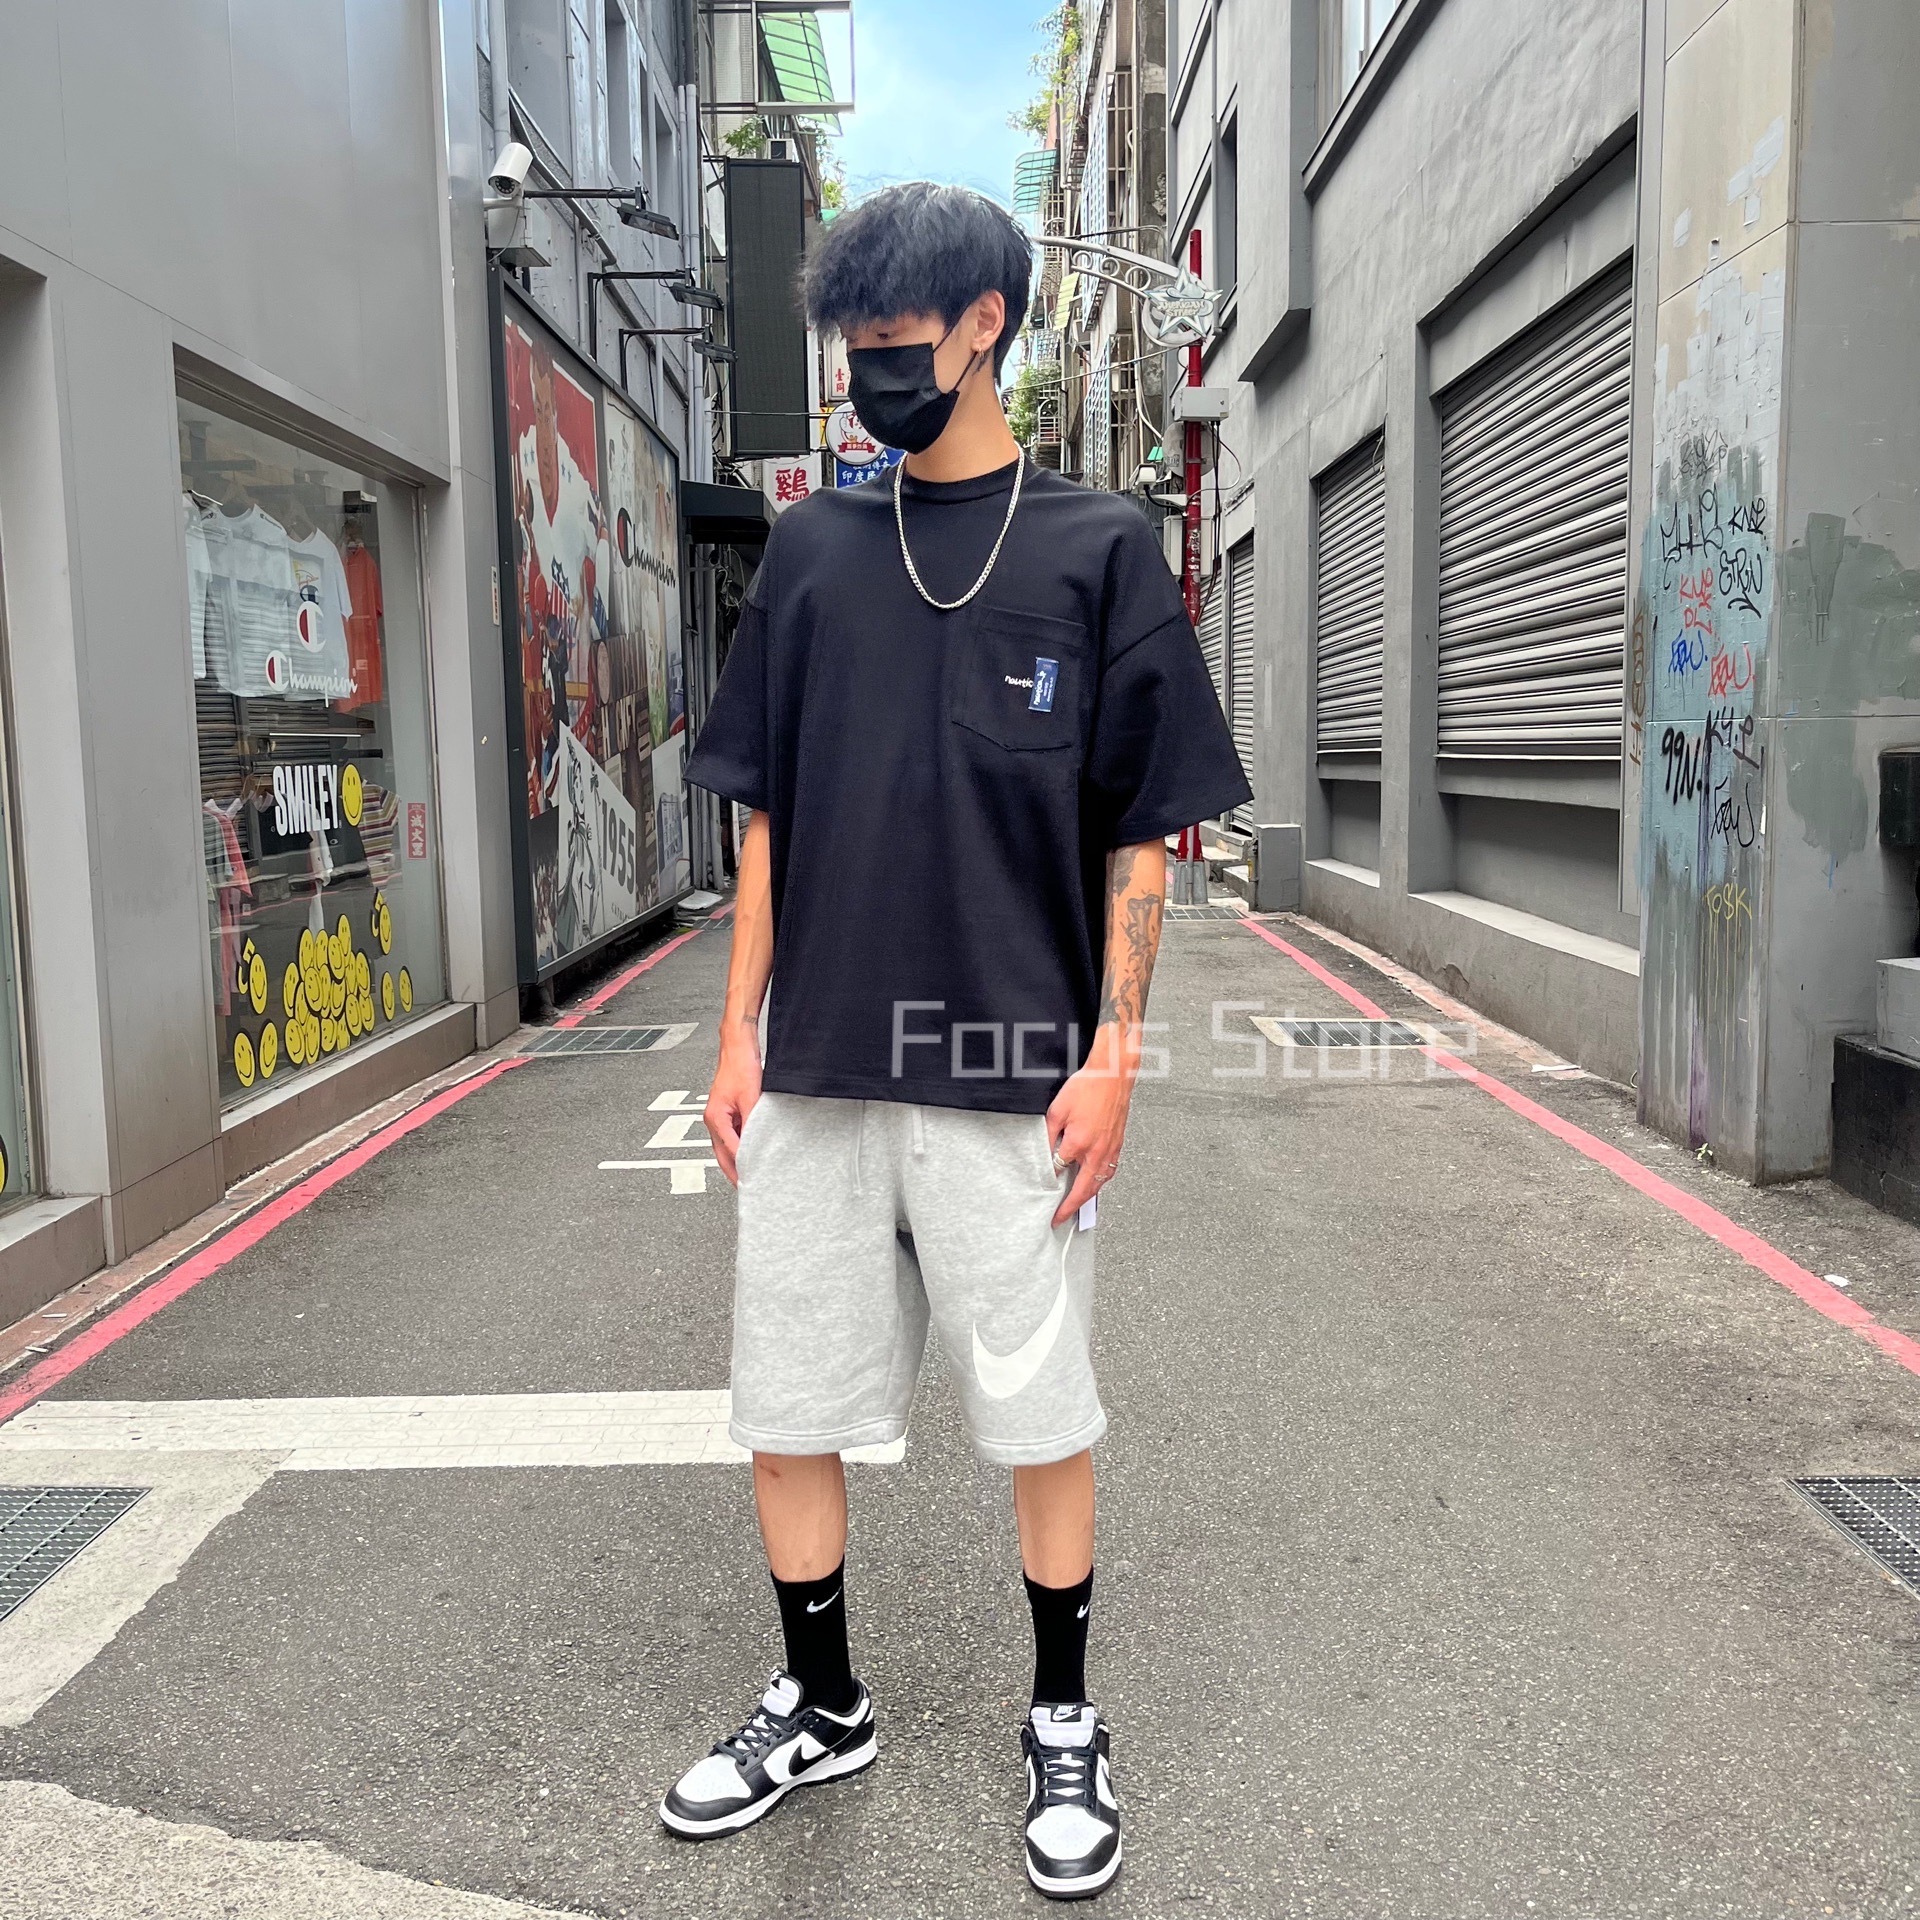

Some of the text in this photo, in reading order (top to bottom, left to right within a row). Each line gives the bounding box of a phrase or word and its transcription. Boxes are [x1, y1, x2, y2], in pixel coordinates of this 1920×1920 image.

[617, 507, 676, 603] Champion
[265, 650, 358, 708] Champion
[272, 764, 337, 837] SMILEY
[602, 798, 635, 895] 1955
